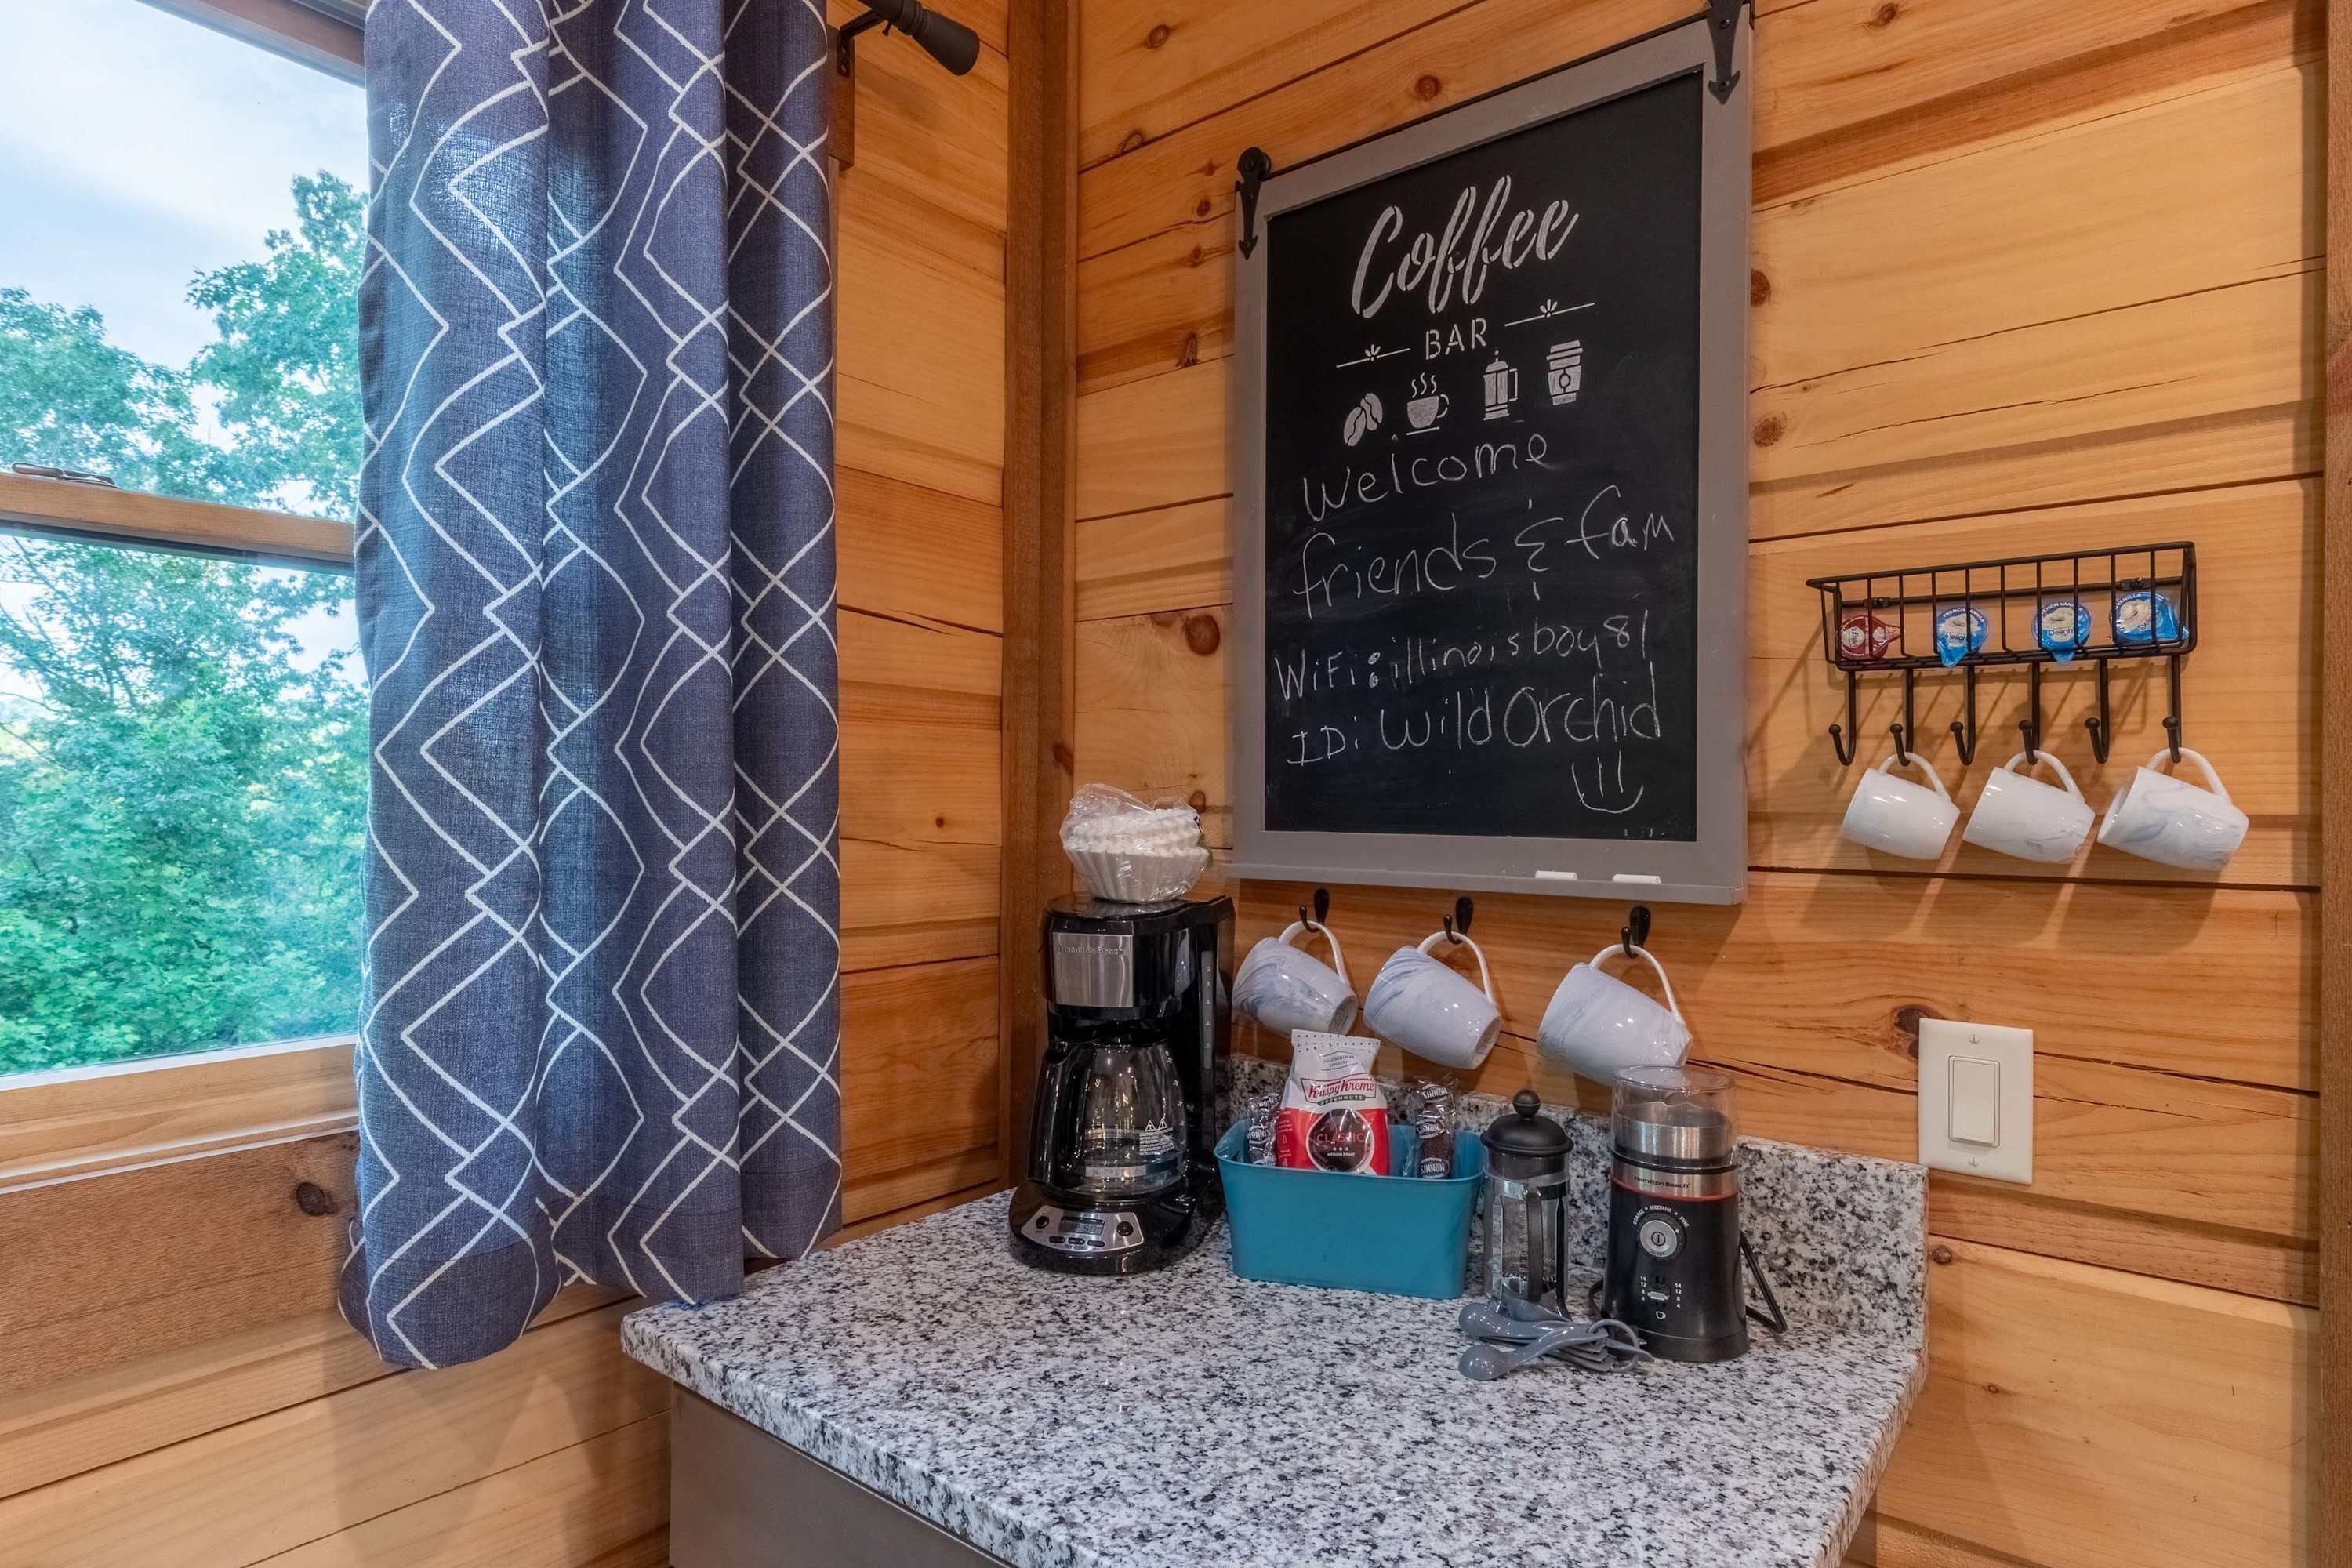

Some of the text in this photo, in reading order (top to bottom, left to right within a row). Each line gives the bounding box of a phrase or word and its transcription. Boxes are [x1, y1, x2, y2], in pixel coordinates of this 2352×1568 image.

[1351, 174, 1580, 319] Coffee
[1425, 317, 1487, 361] BAR
[1945, 632, 1967, 642] Deligh
[2049, 627, 2074, 637] Deligh
[1308, 1079, 1375, 1098] Krispy Kreme
[1316, 1132, 1365, 1144] CLASSIC
[1635, 1176, 1664, 1187] Hamilton
[1649, 1204, 1672, 1214] MEDIUM
